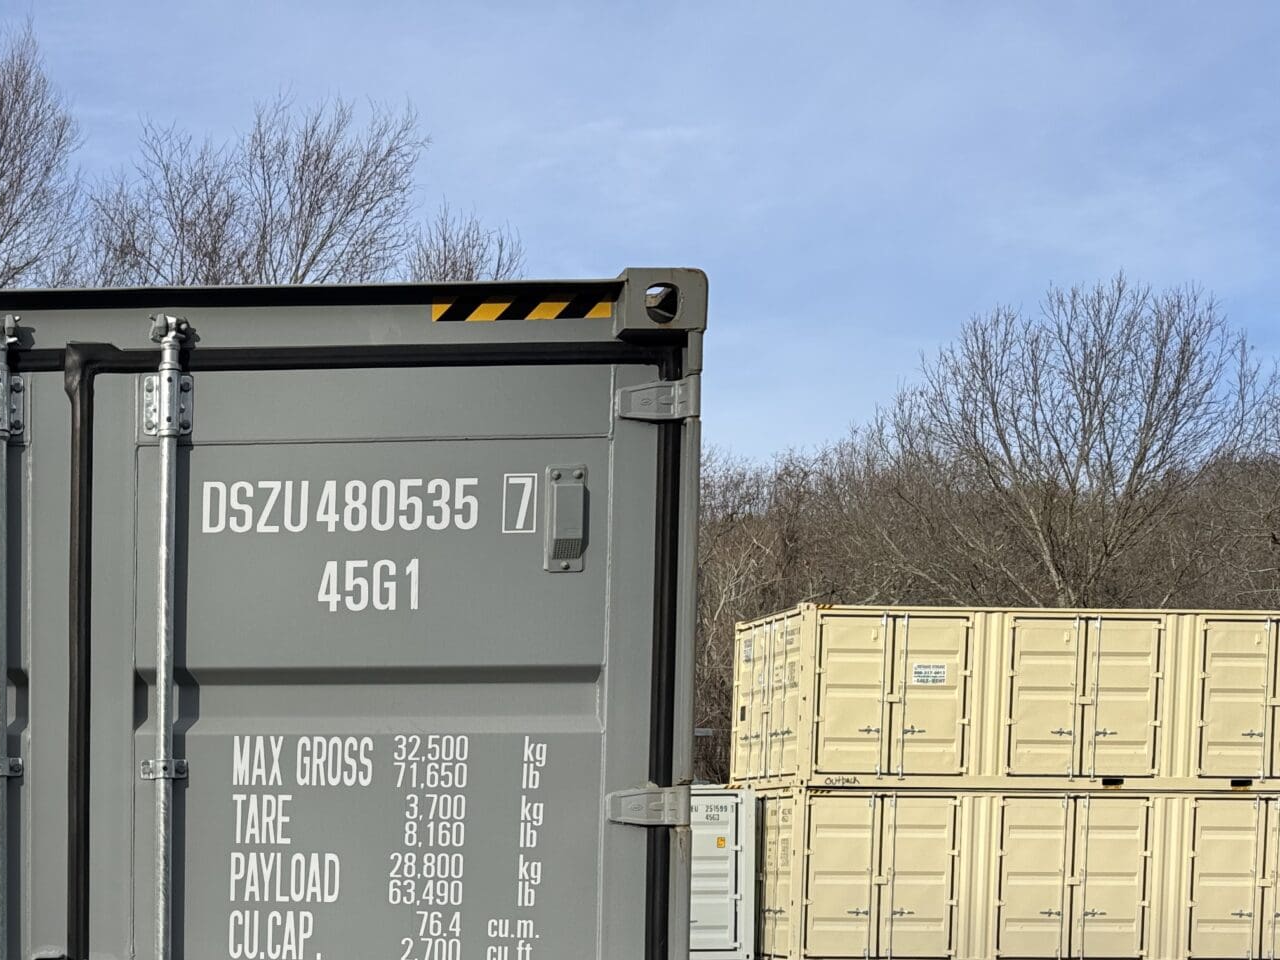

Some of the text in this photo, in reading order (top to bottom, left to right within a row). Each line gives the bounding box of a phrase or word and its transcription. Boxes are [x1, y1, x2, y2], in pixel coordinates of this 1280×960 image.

[507, 477, 532, 530] 7
[318, 558, 420, 612] 45G1
[232, 736, 374, 786] MAX GROSS
[393, 735, 547, 766] 32,500 kg
[393, 763, 539, 789] 71,650 lb
[232, 794, 292, 844] TARE
[404, 794, 544, 826] 3,700 kg
[404, 822, 537, 848] 8,160 lb
[230, 852, 340, 902] PAYLOAD
[389, 853, 542, 885] 28,800 kg
[388, 880, 535, 906] 63,490 lb
[416, 911, 539, 939] 76.4 cu.m.
